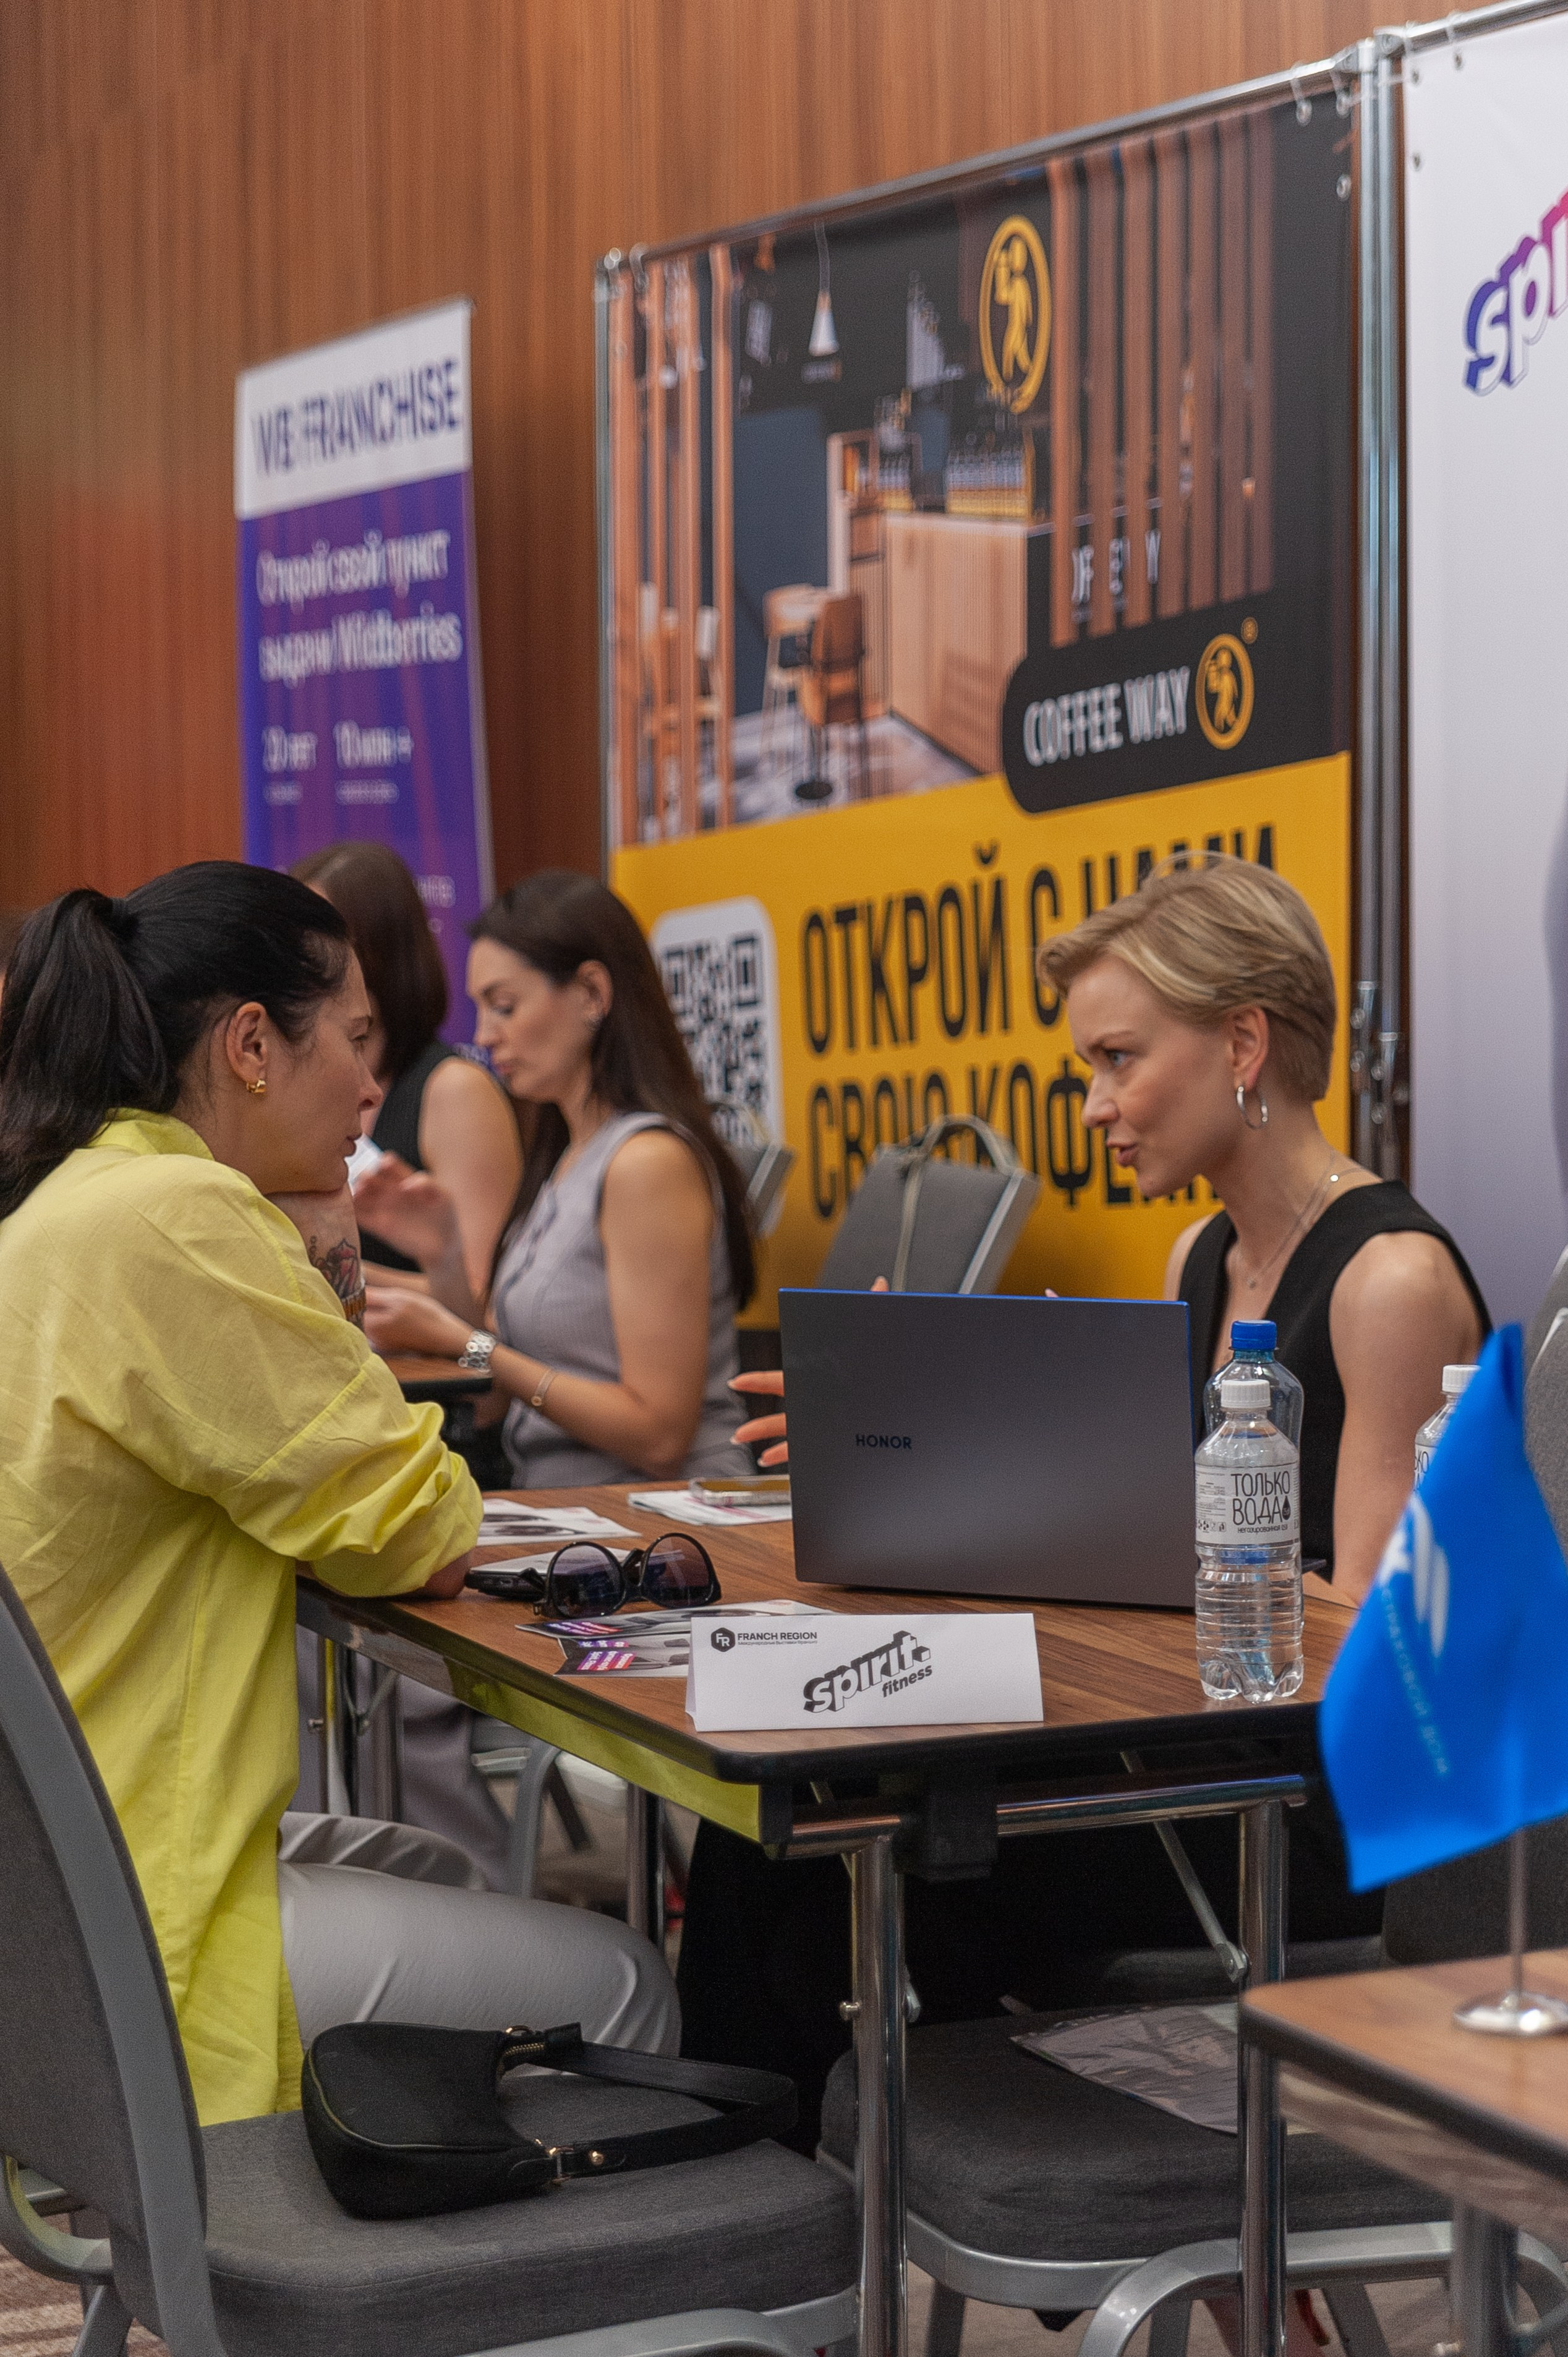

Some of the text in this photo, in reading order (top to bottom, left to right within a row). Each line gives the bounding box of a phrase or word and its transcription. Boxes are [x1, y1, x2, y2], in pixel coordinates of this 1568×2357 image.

[299, 356, 459, 463] FRANCHISE
[1023, 665, 1190, 766] COFFEE WAY
[804, 842, 1010, 1053] ОТКРОЙ
[855, 1434, 911, 1449] HONOR
[1230, 1471, 1290, 1497] ТОЛЬКО
[1232, 1496, 1282, 1525] ВОДА
[715, 1633, 730, 1646] FR
[882, 1666, 932, 1698] fitness
